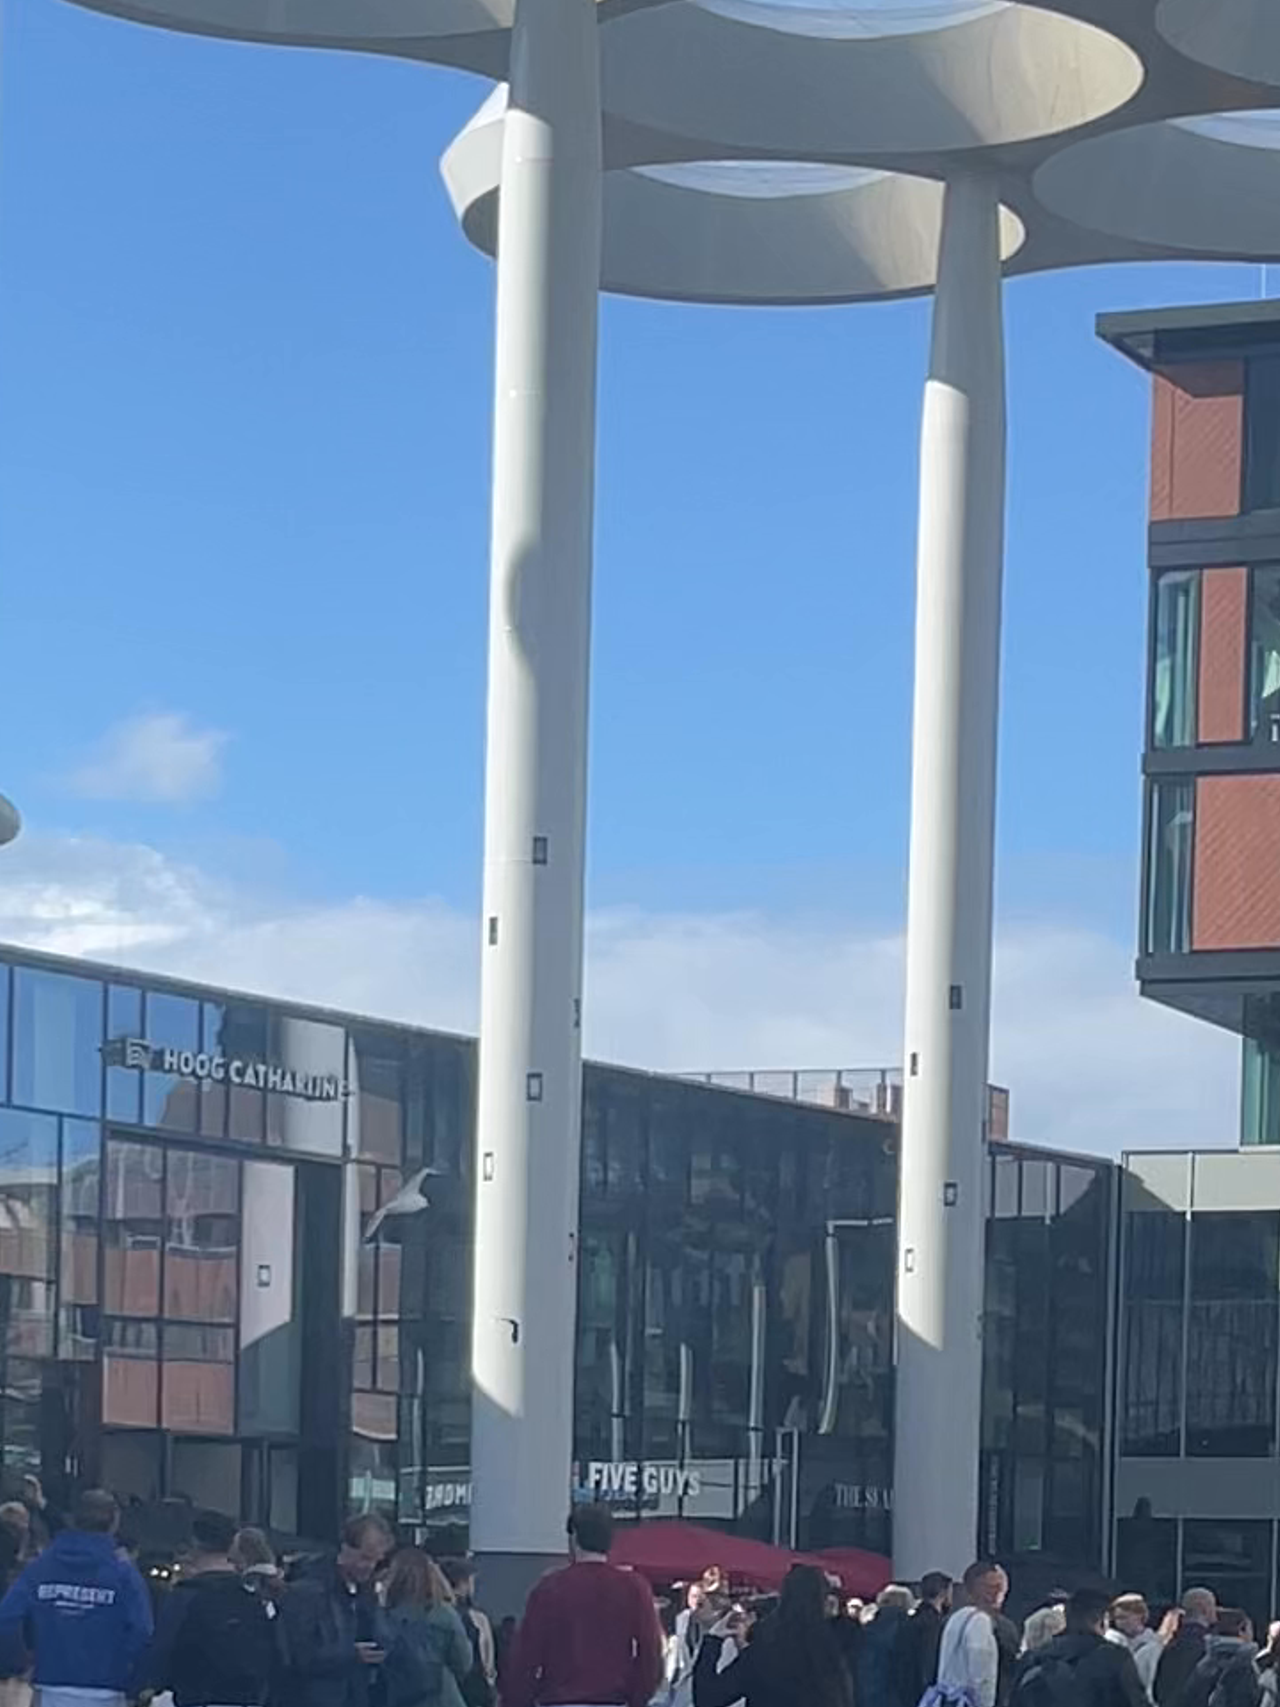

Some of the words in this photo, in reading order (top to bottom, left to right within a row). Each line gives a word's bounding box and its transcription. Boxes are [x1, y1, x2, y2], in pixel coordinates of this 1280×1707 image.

[164, 1048, 226, 1080] HOOG
[587, 1461, 639, 1492] FIVE
[642, 1465, 701, 1496] GUYS
